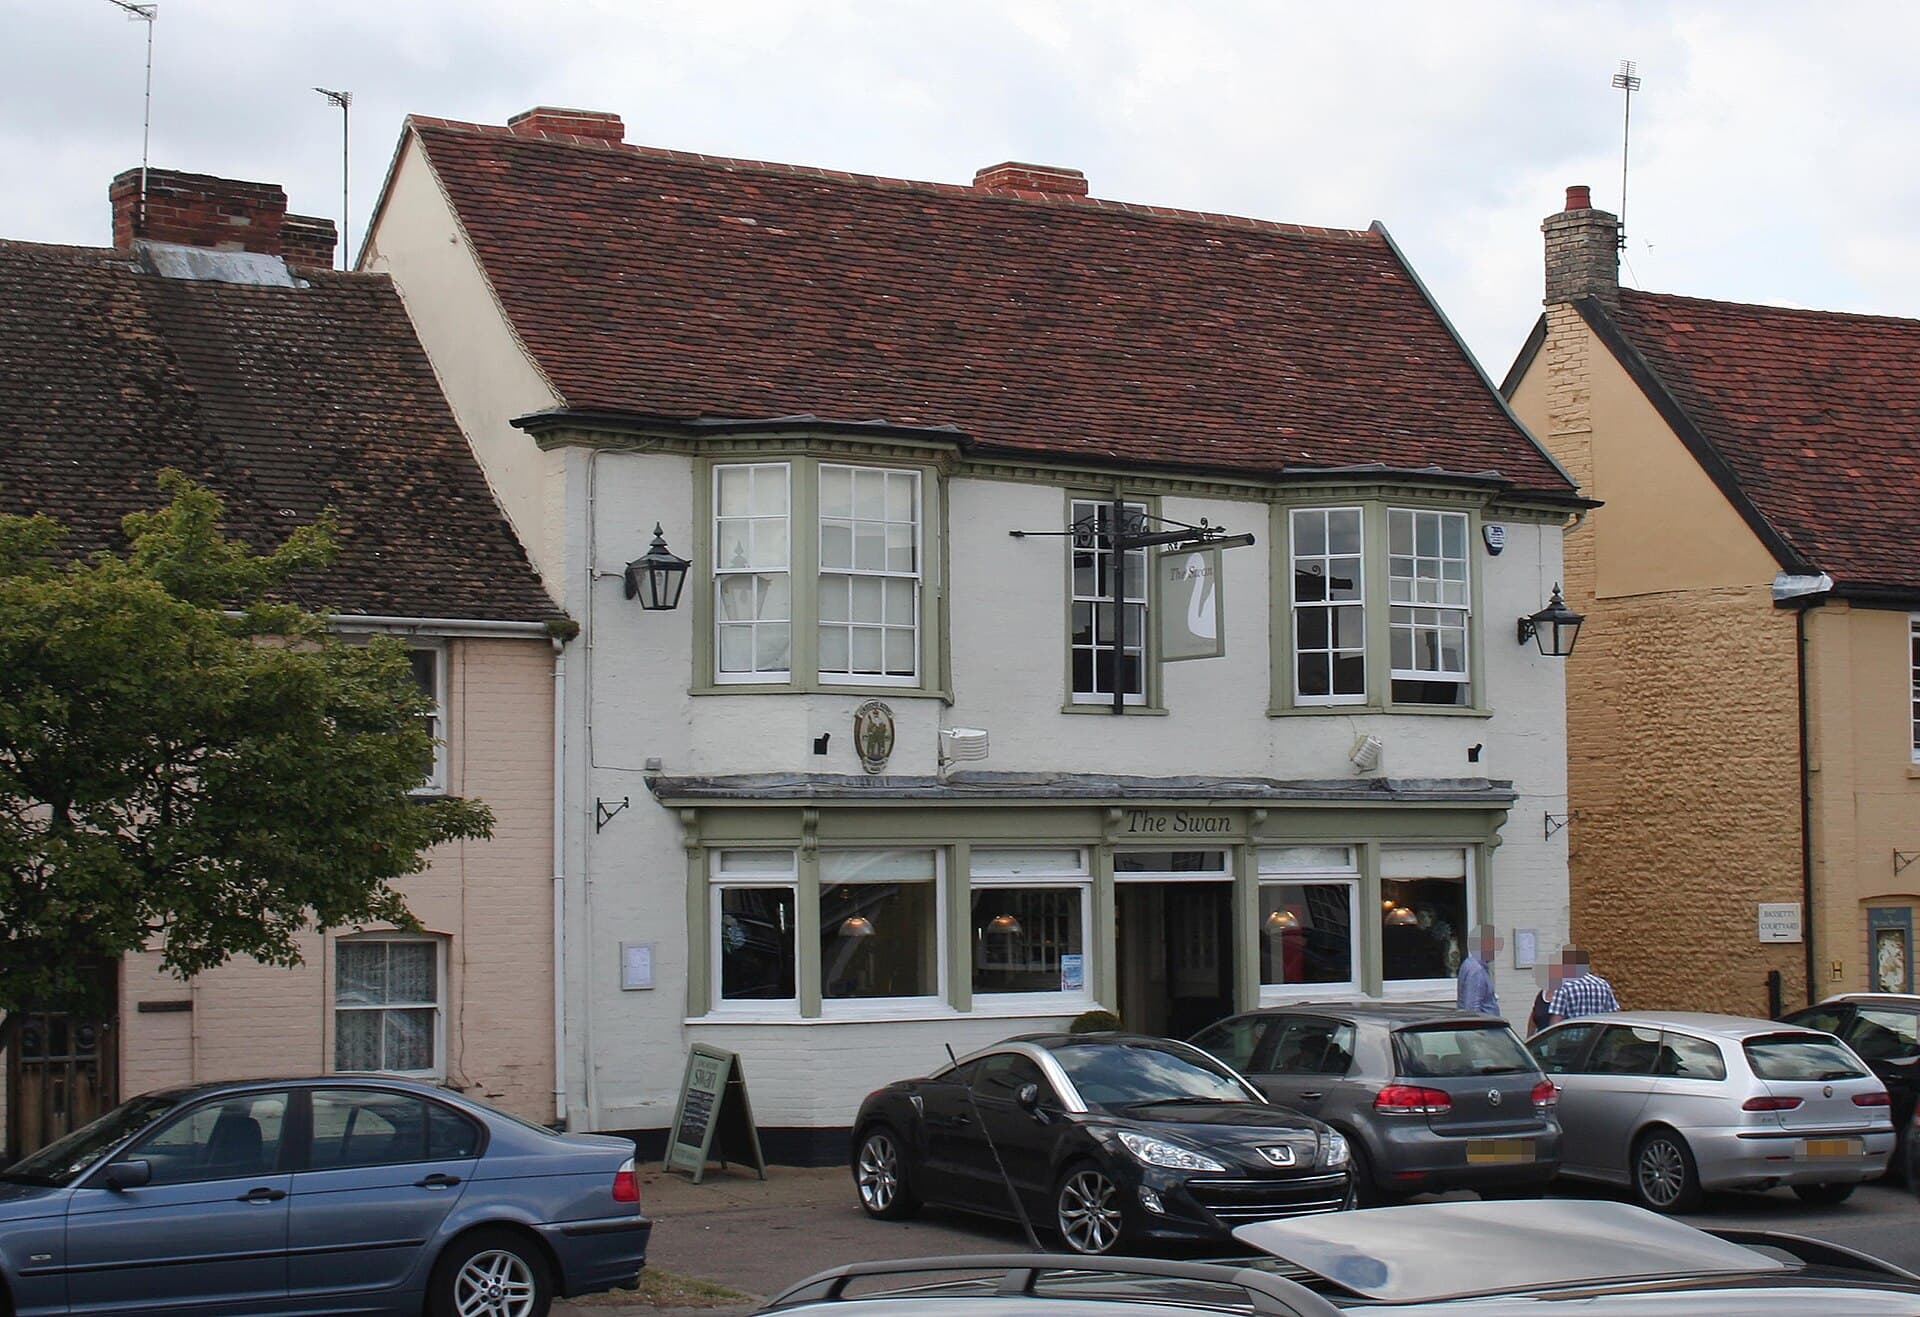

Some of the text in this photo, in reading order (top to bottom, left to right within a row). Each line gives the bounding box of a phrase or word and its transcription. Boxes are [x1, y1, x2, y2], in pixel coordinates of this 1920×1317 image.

[1170, 565, 1214, 581] The Swan
[1127, 808, 1232, 833] The Swan
